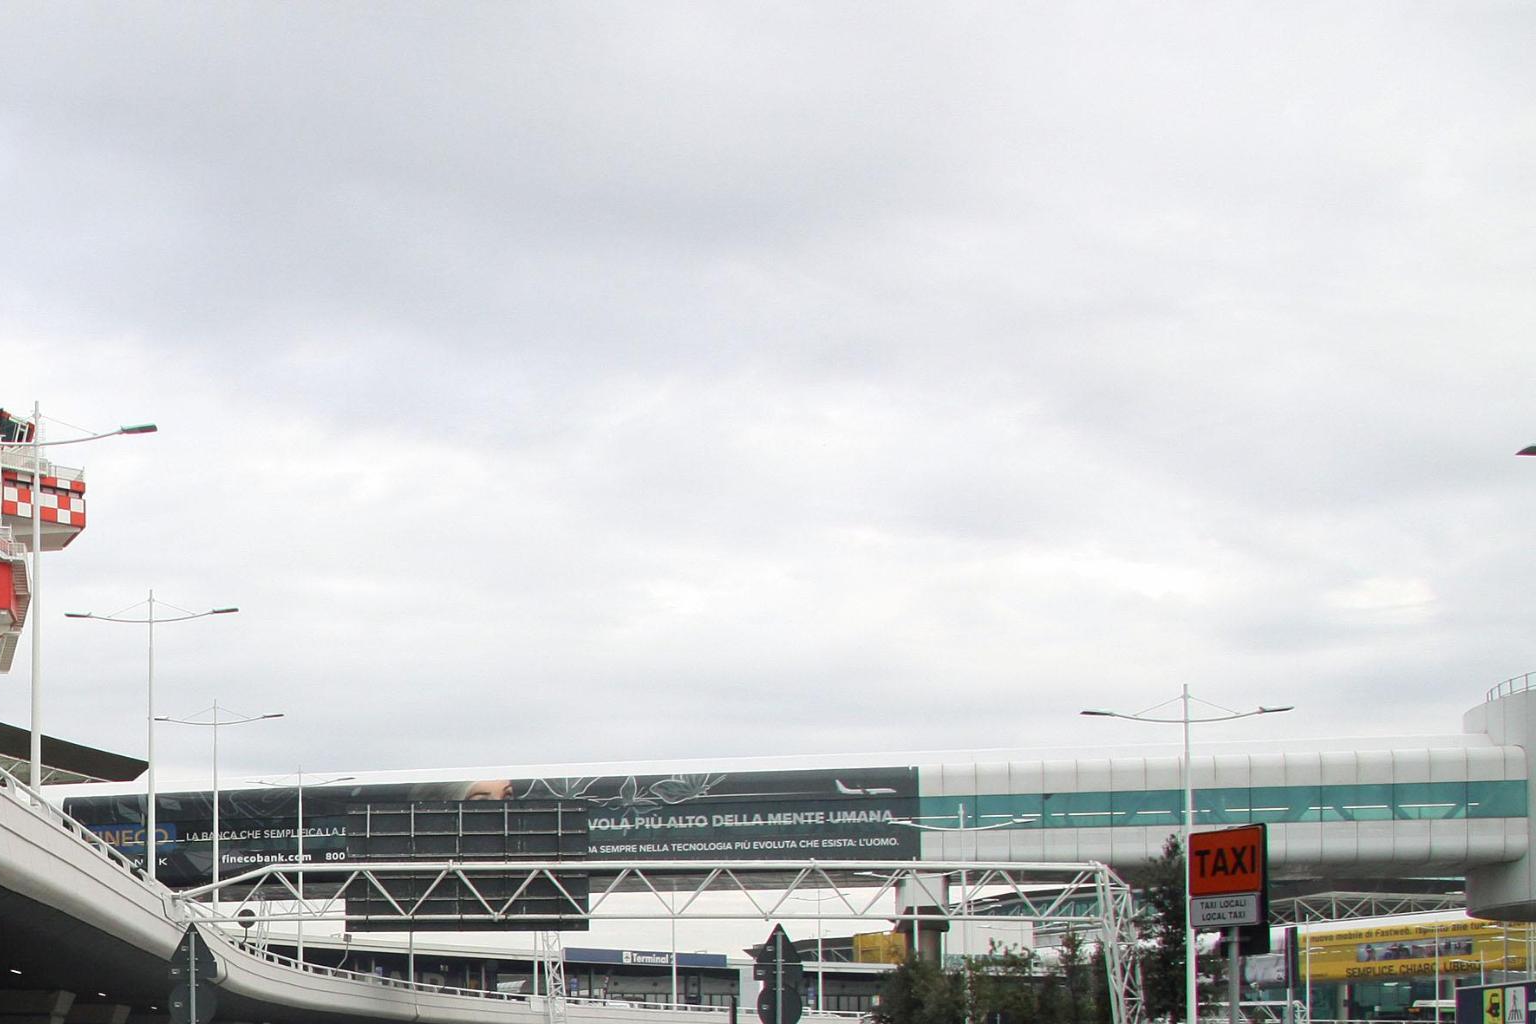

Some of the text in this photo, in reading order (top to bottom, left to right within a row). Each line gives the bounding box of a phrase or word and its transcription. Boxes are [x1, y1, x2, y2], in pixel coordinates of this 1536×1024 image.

[588, 809, 892, 831] VOLA PIÙ ALTO DELLA MENTE UMANA
[186, 832, 198, 841] LA
[240, 829, 261, 839] CHE
[600, 844, 637, 854] SEMPRE
[640, 843, 668, 853] NELLA
[671, 842, 732, 851] TECNOLOGIA
[735, 840, 750, 850] PIÙ
[753, 839, 797, 850] EVOLUTA
[799, 839, 820, 848] CHE
[822, 838, 857, 848] ESISTA:
[221, 852, 345, 864] finecobank.com 800
[1194, 845, 1256, 878] TAXI
[1200, 900, 1247, 910] TAXI LOCALI
[1202, 911, 1246, 921] LOCAL TAXI
[632, 954, 669, 964] Terminal
